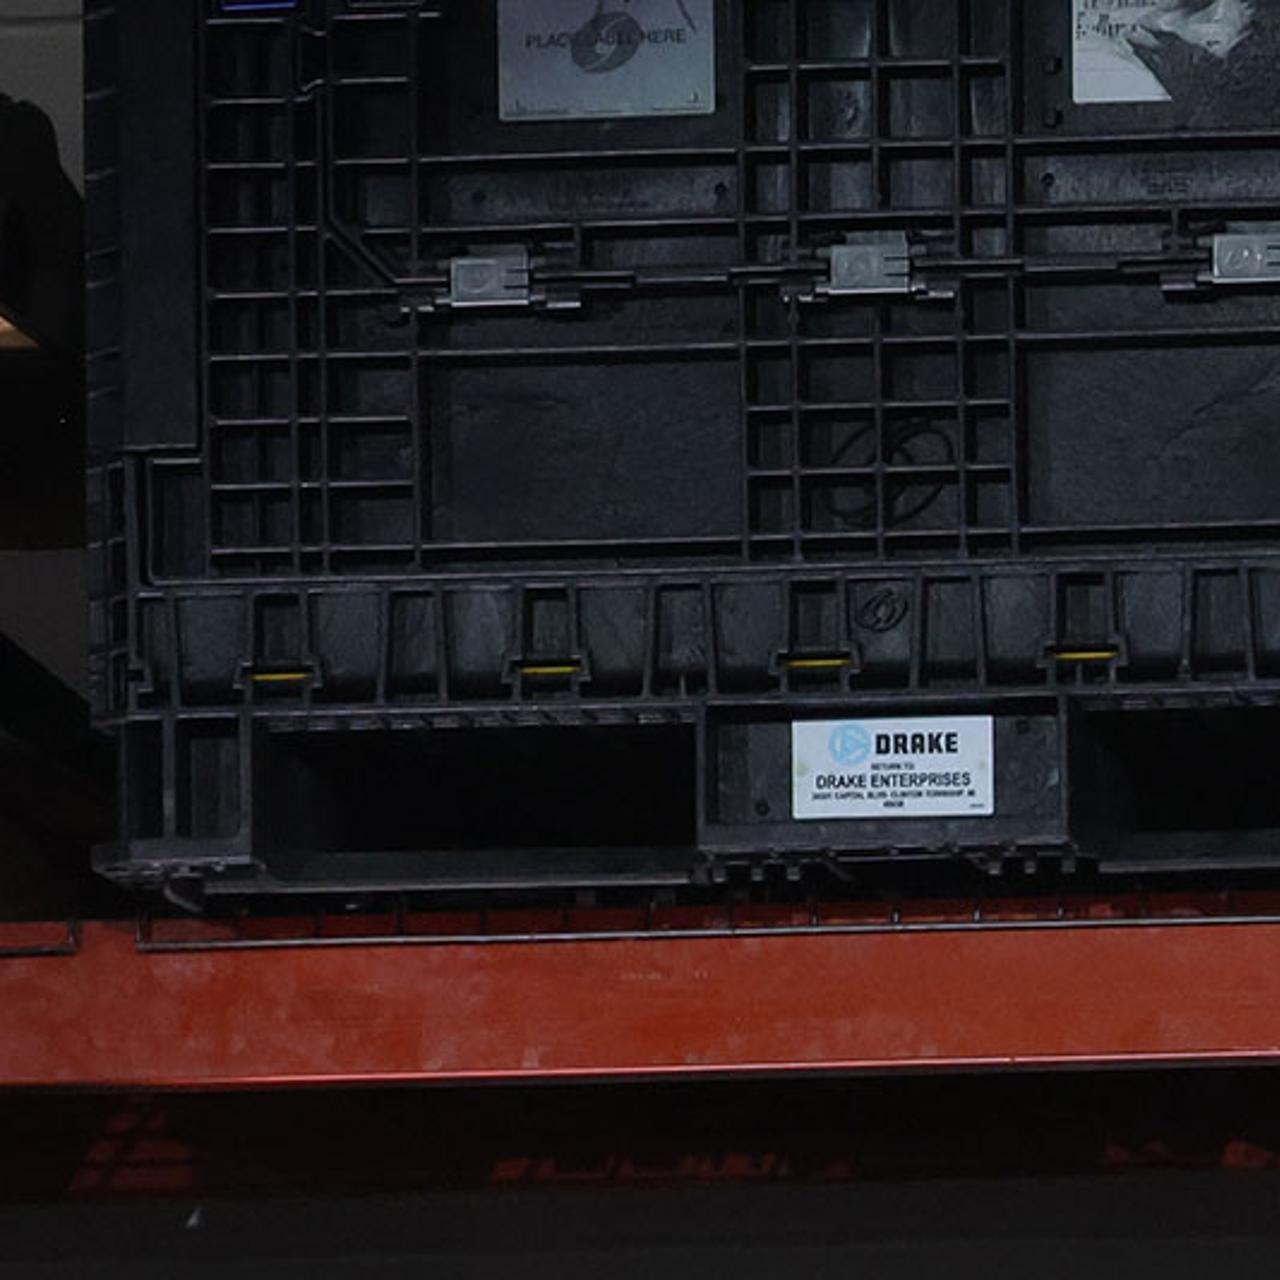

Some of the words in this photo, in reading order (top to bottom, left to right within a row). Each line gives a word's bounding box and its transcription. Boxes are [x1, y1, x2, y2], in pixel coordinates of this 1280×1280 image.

[875, 732, 958, 755] DRAKE
[816, 774, 867, 790] DRAKE
[870, 771, 971, 789] ENTERPRISES
